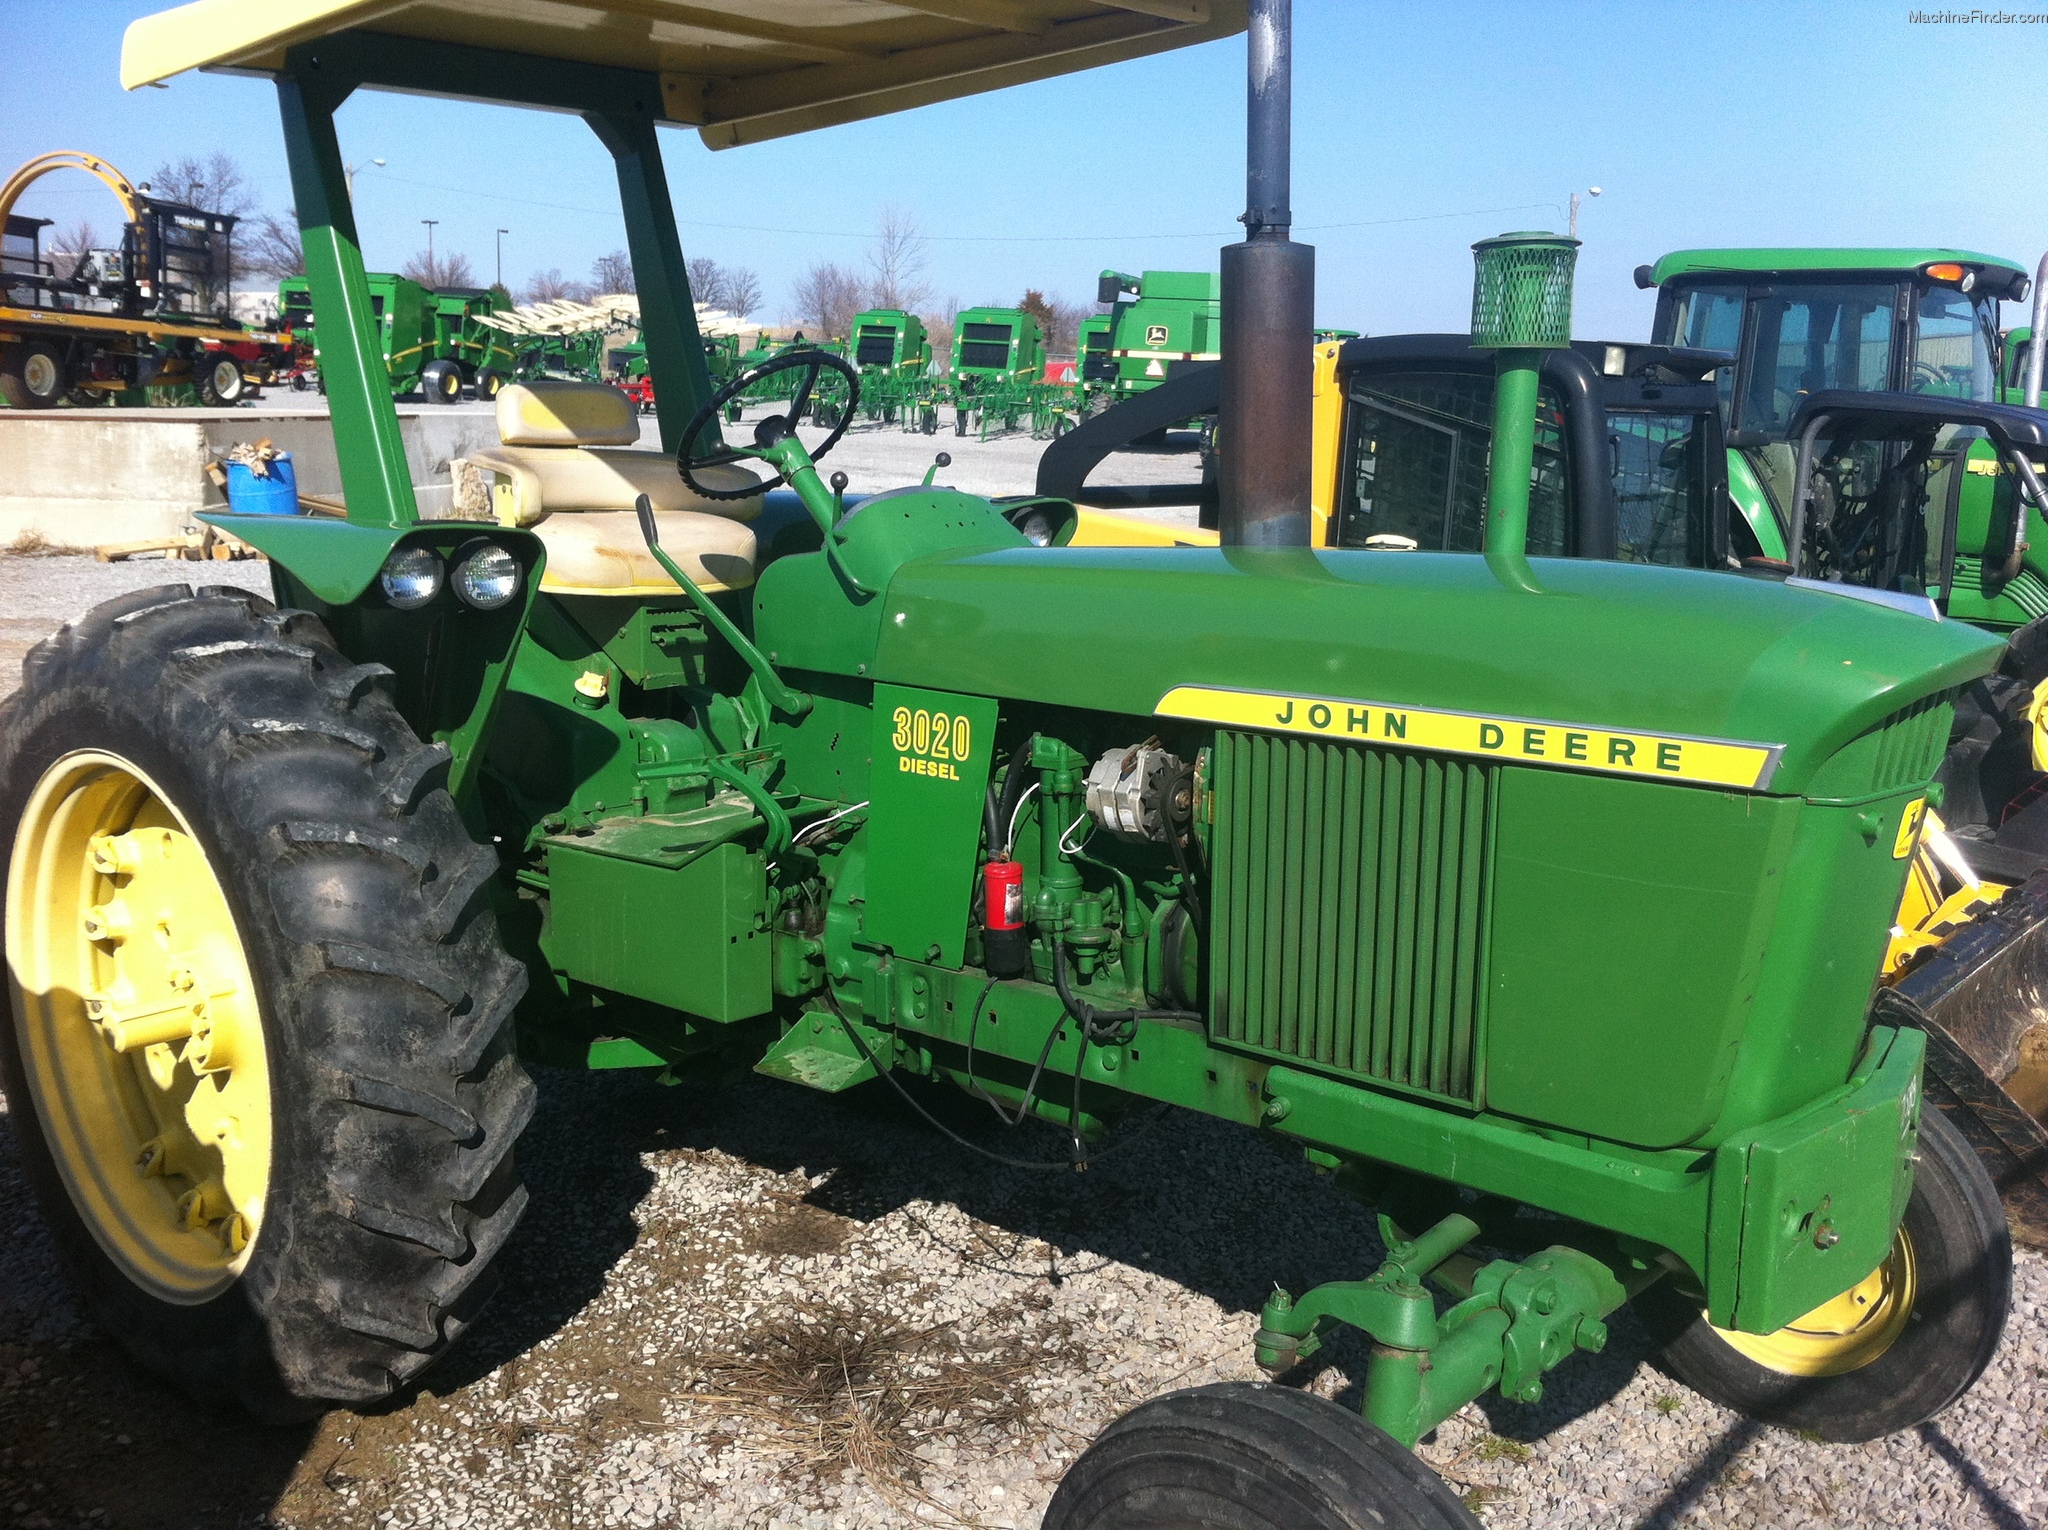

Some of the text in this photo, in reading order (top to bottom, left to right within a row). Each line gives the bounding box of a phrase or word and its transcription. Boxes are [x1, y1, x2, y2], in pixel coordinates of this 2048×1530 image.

[892, 706, 970, 761] 3020
[1276, 701, 1683, 772] JOHN DEERE
[899, 756, 960, 781] DIESEL
